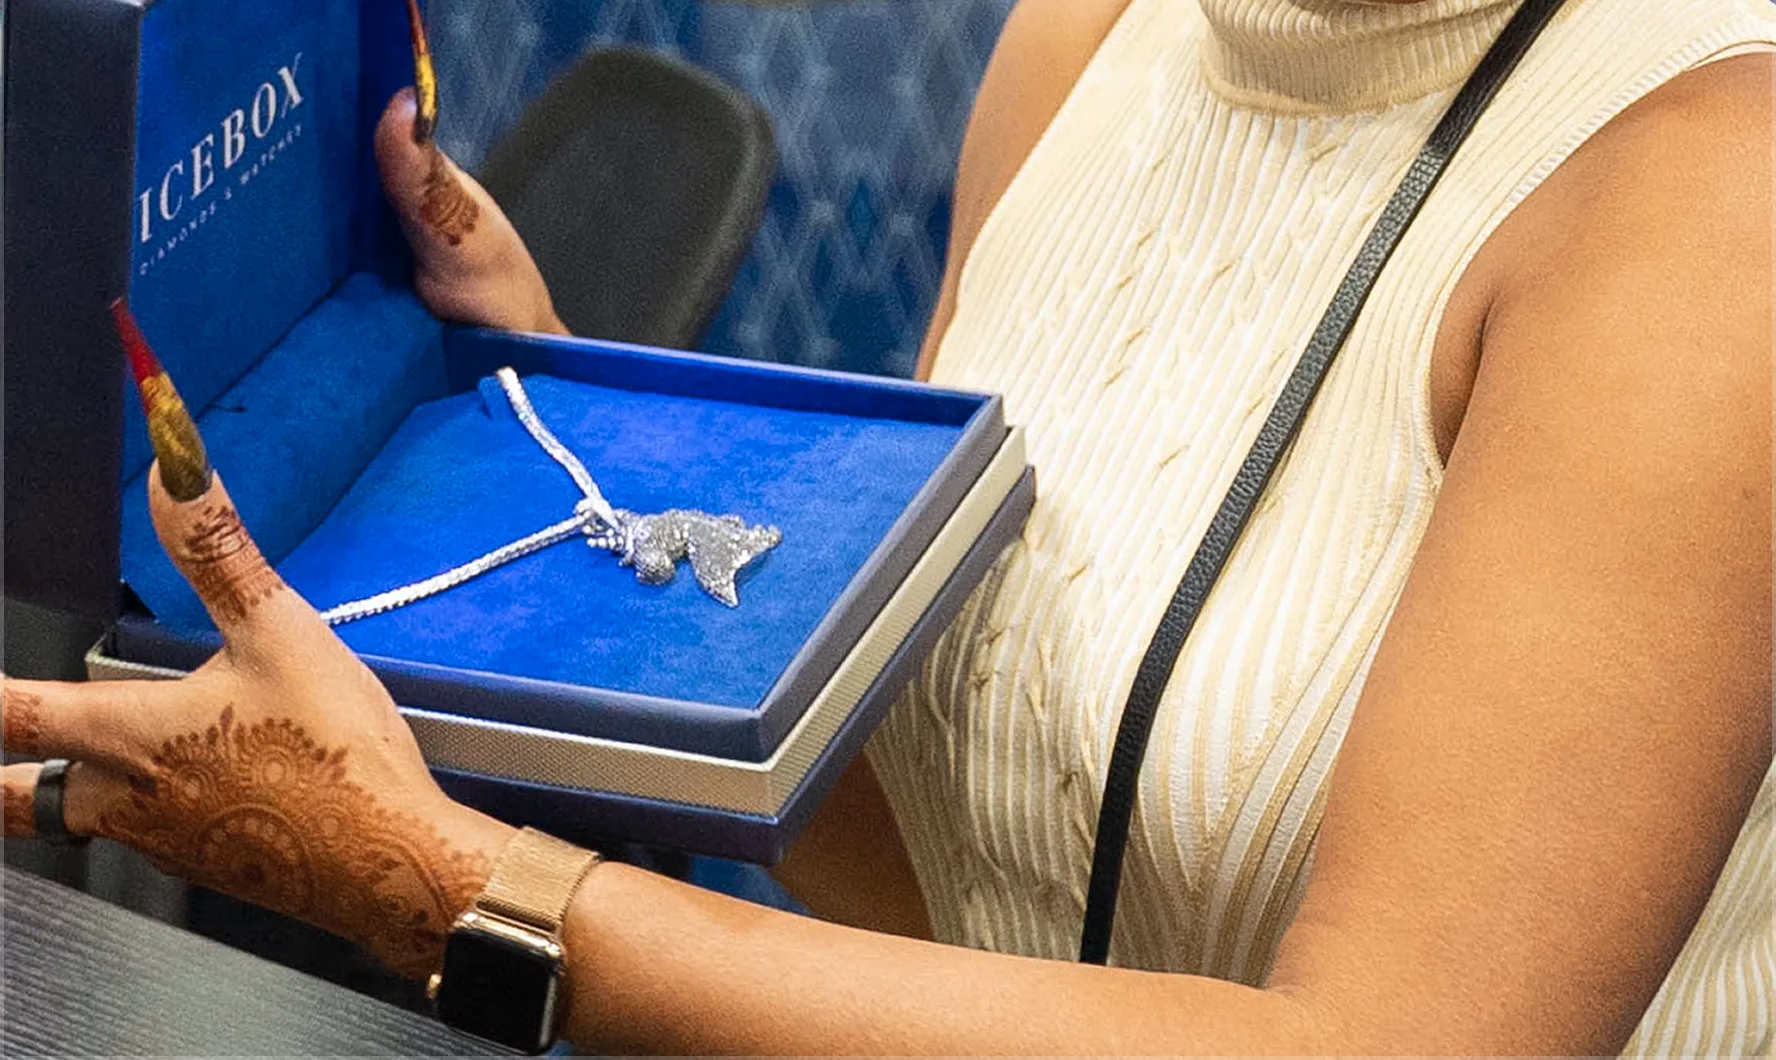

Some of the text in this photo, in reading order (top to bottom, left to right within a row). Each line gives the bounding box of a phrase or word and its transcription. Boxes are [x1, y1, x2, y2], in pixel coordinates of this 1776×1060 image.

[137, 52, 304, 243] ICEBOX
[139, 201, 216, 275] DIAMONDS
[240, 124, 301, 185] WATCHES
